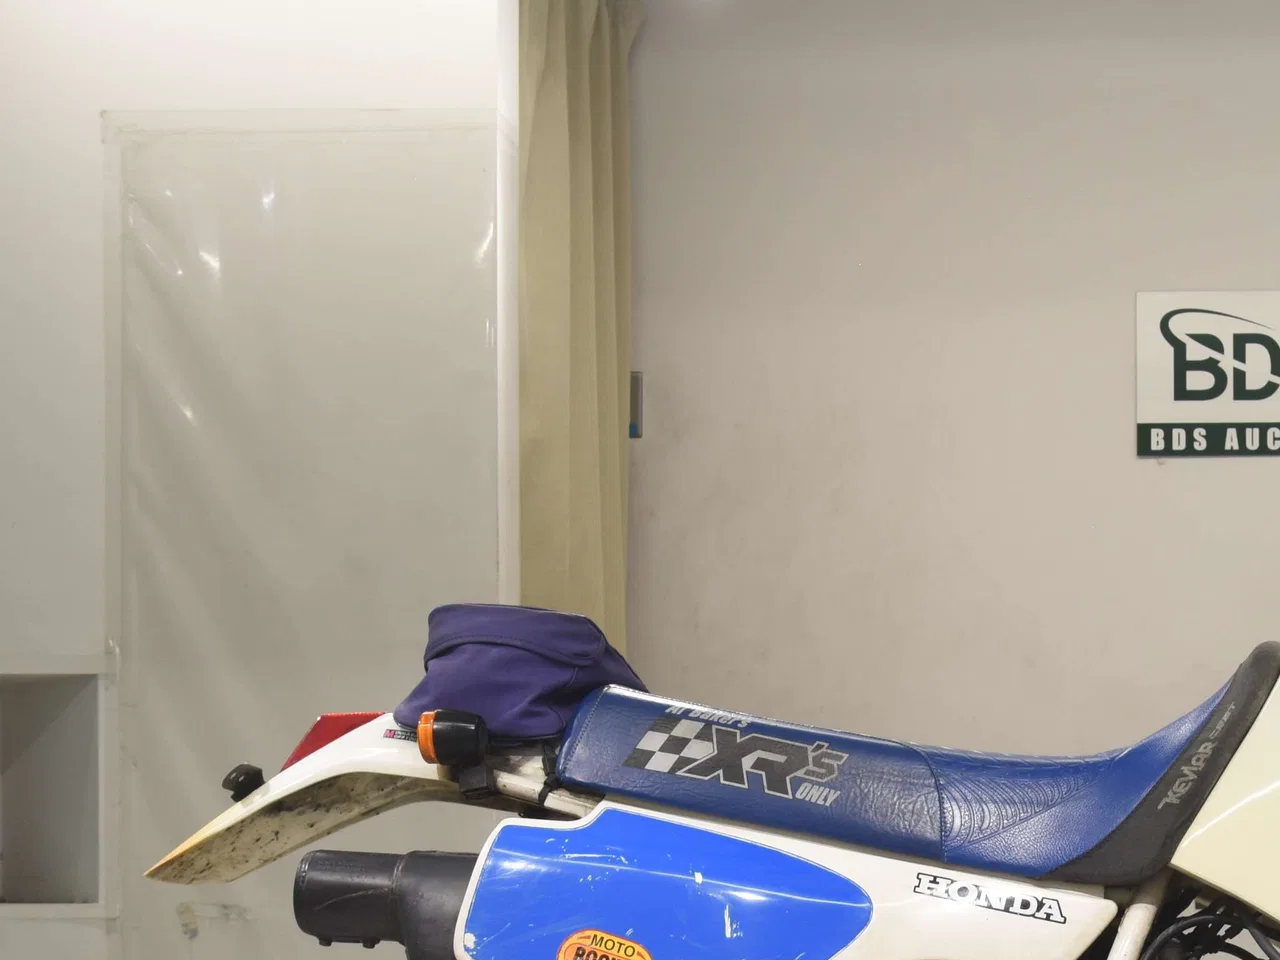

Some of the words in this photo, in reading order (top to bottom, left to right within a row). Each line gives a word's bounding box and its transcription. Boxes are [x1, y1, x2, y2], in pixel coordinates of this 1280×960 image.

[1150, 427, 1208, 451] BDS
[794, 782, 842, 807] ONLY
[913, 872, 1067, 925] HONDA
[589, 933, 636, 958] MOTO
